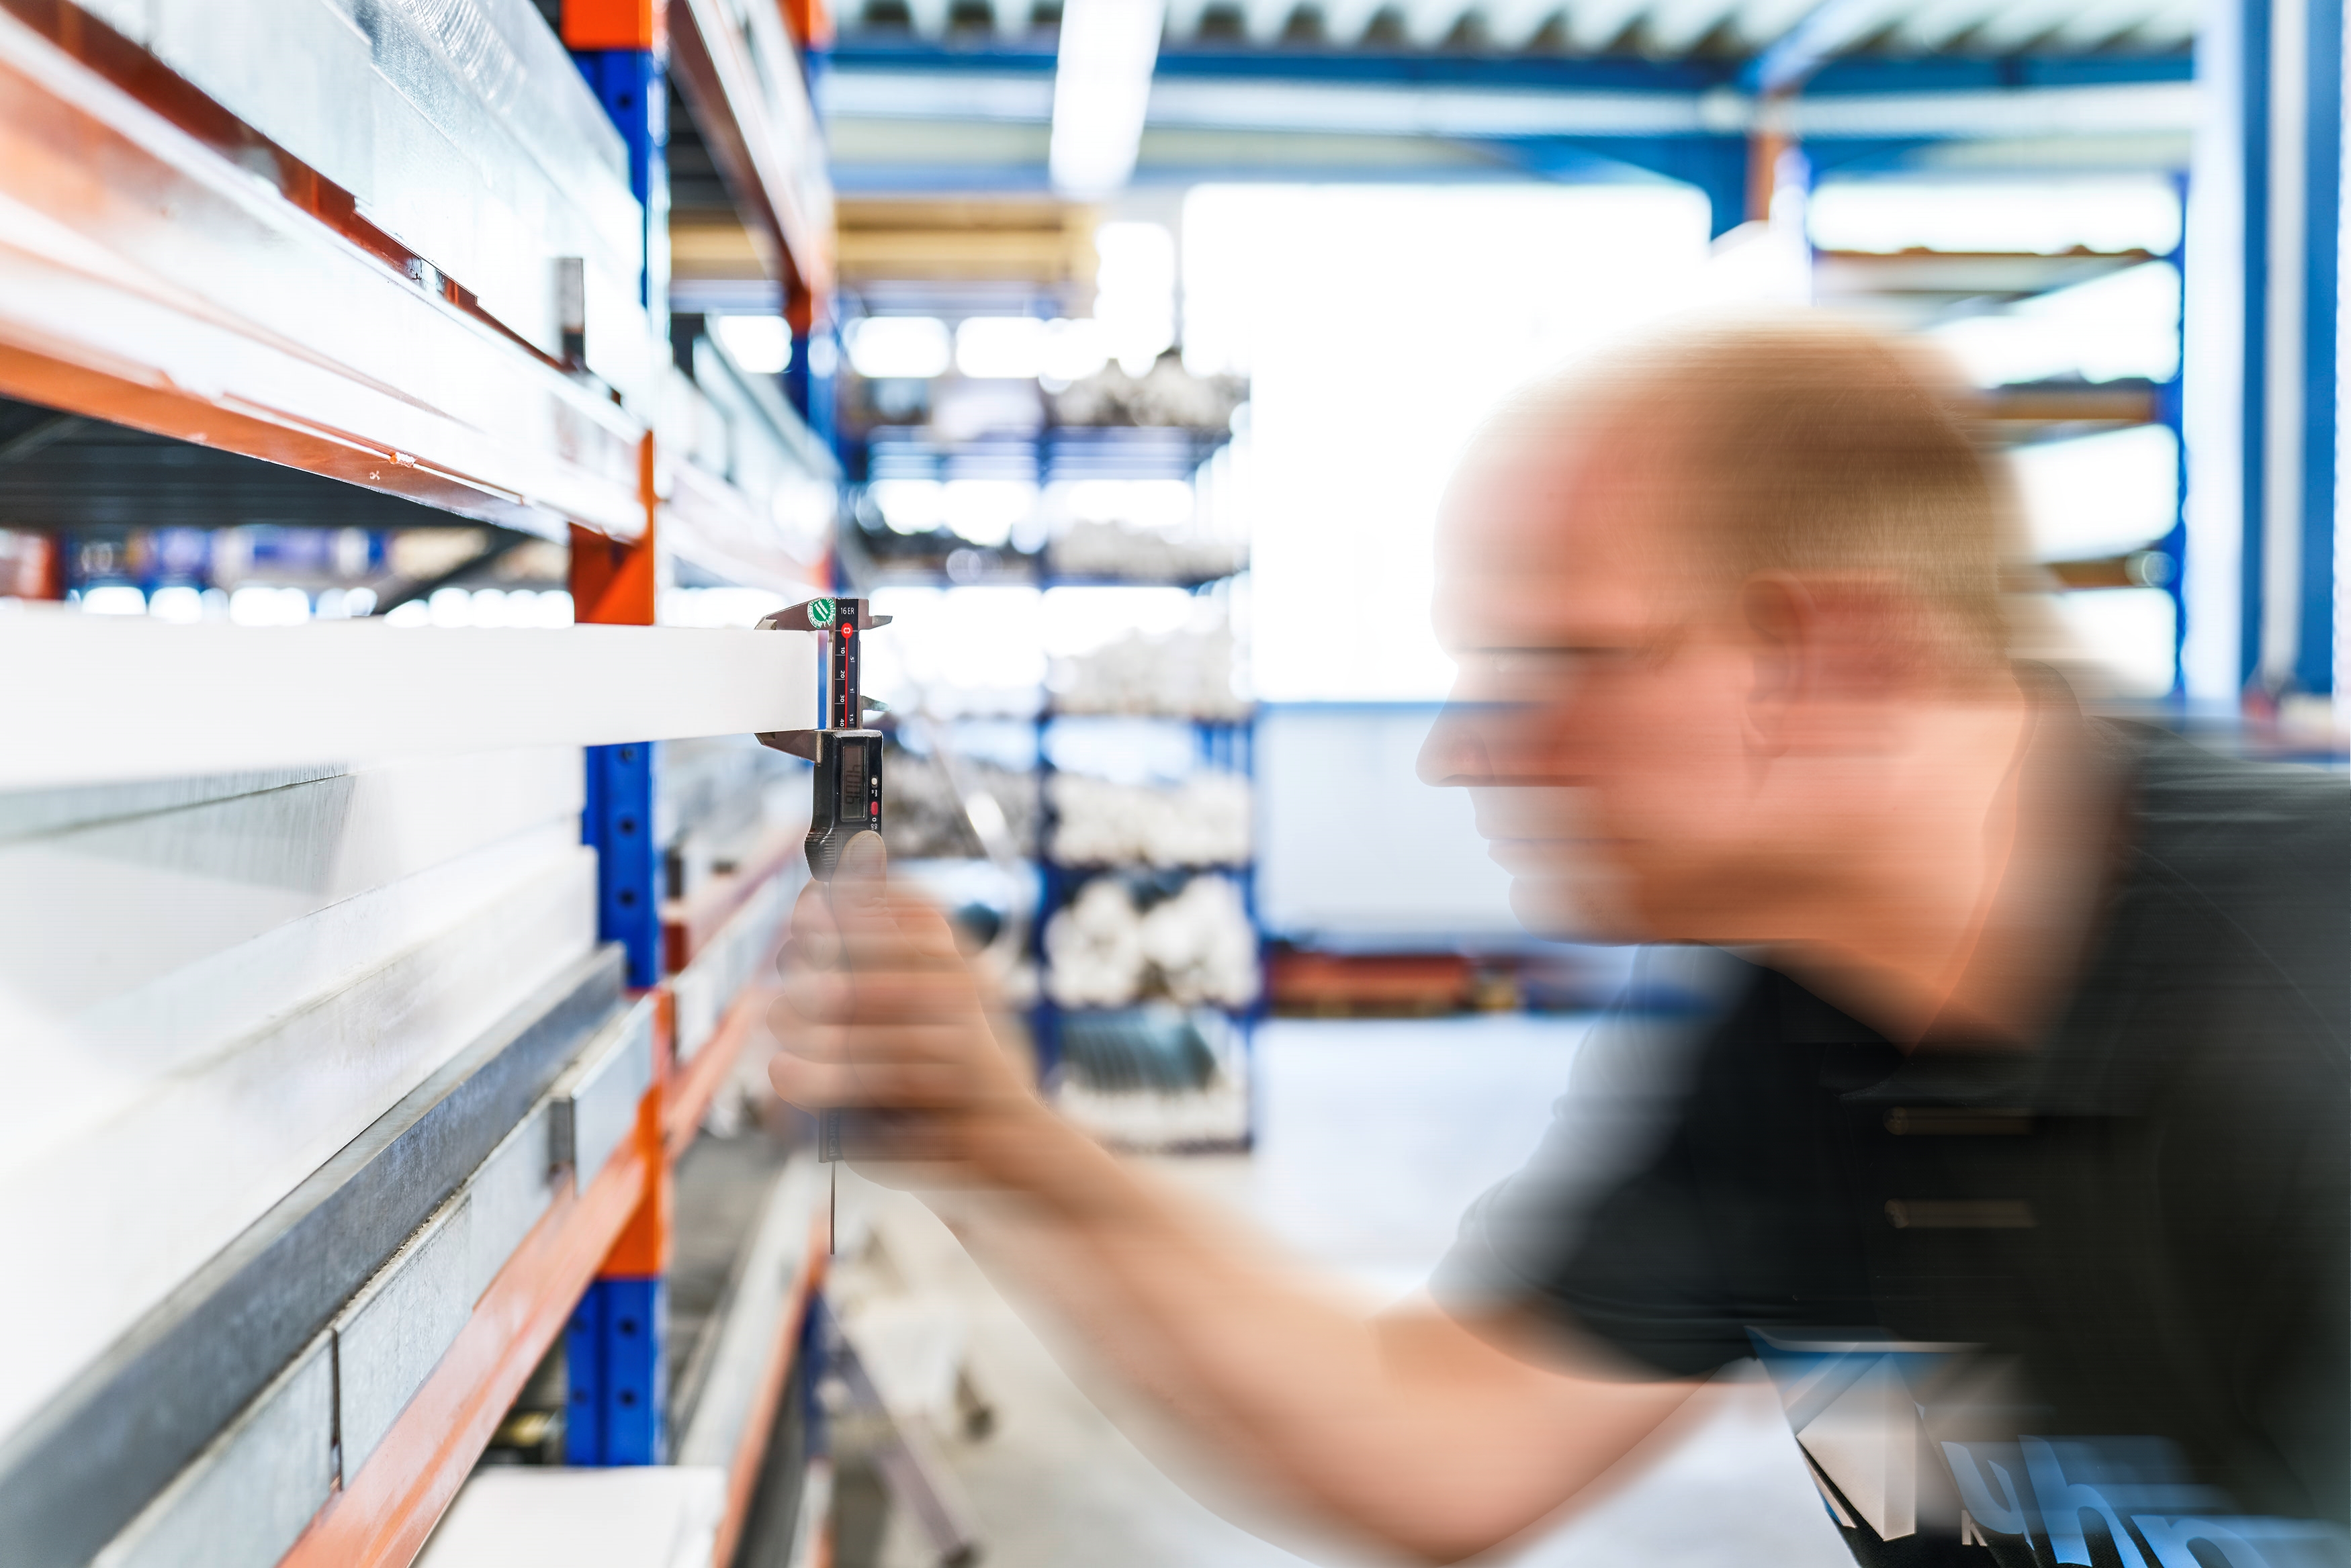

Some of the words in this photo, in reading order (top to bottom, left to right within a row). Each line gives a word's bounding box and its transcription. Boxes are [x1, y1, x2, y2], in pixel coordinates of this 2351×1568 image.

[840, 607, 847, 615] 16
[847, 607, 855, 615] ER
[840, 670, 845, 678] 20
[840, 694, 845, 702] 30
[840, 719, 844, 727] 40
[828, 1112, 838, 1156] MarCal
